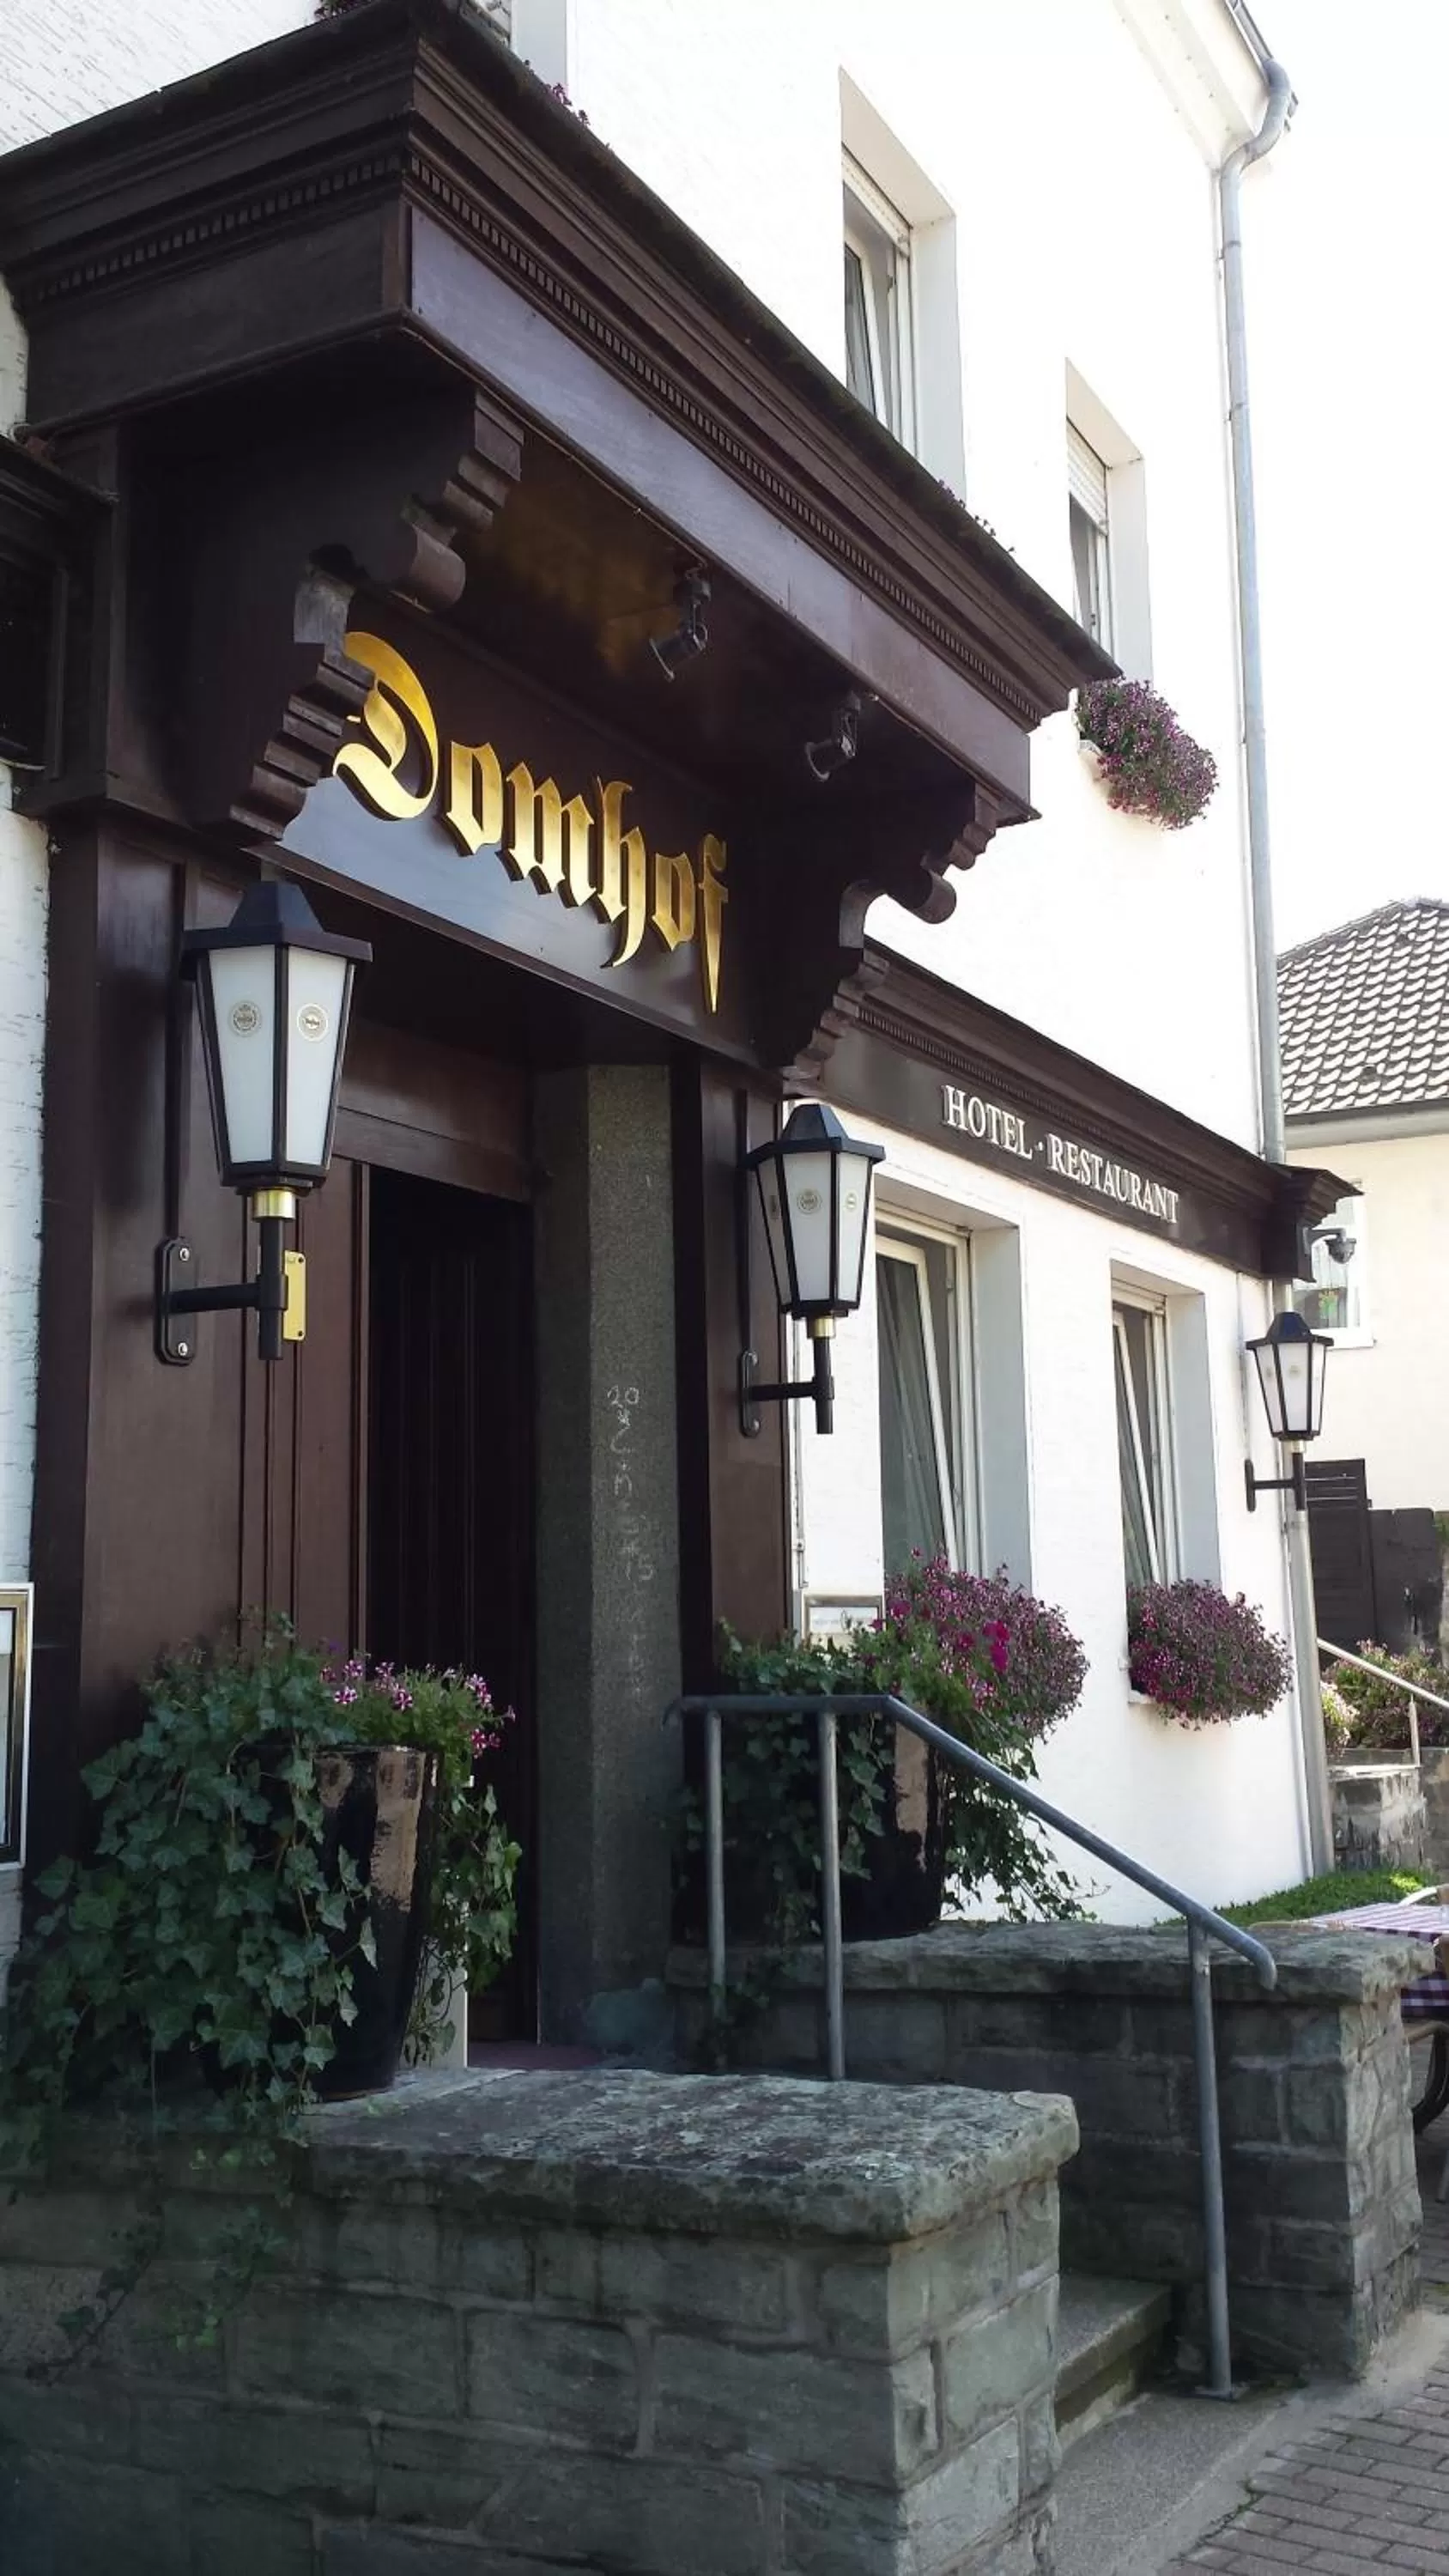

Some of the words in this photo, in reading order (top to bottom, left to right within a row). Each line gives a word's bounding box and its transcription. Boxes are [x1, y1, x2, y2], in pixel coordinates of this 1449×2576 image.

[333, 631, 728, 1013] Domhof
[944, 1084, 1032, 1159] HOTEL
[1046, 1133, 1179, 1224] RESTAURANT
